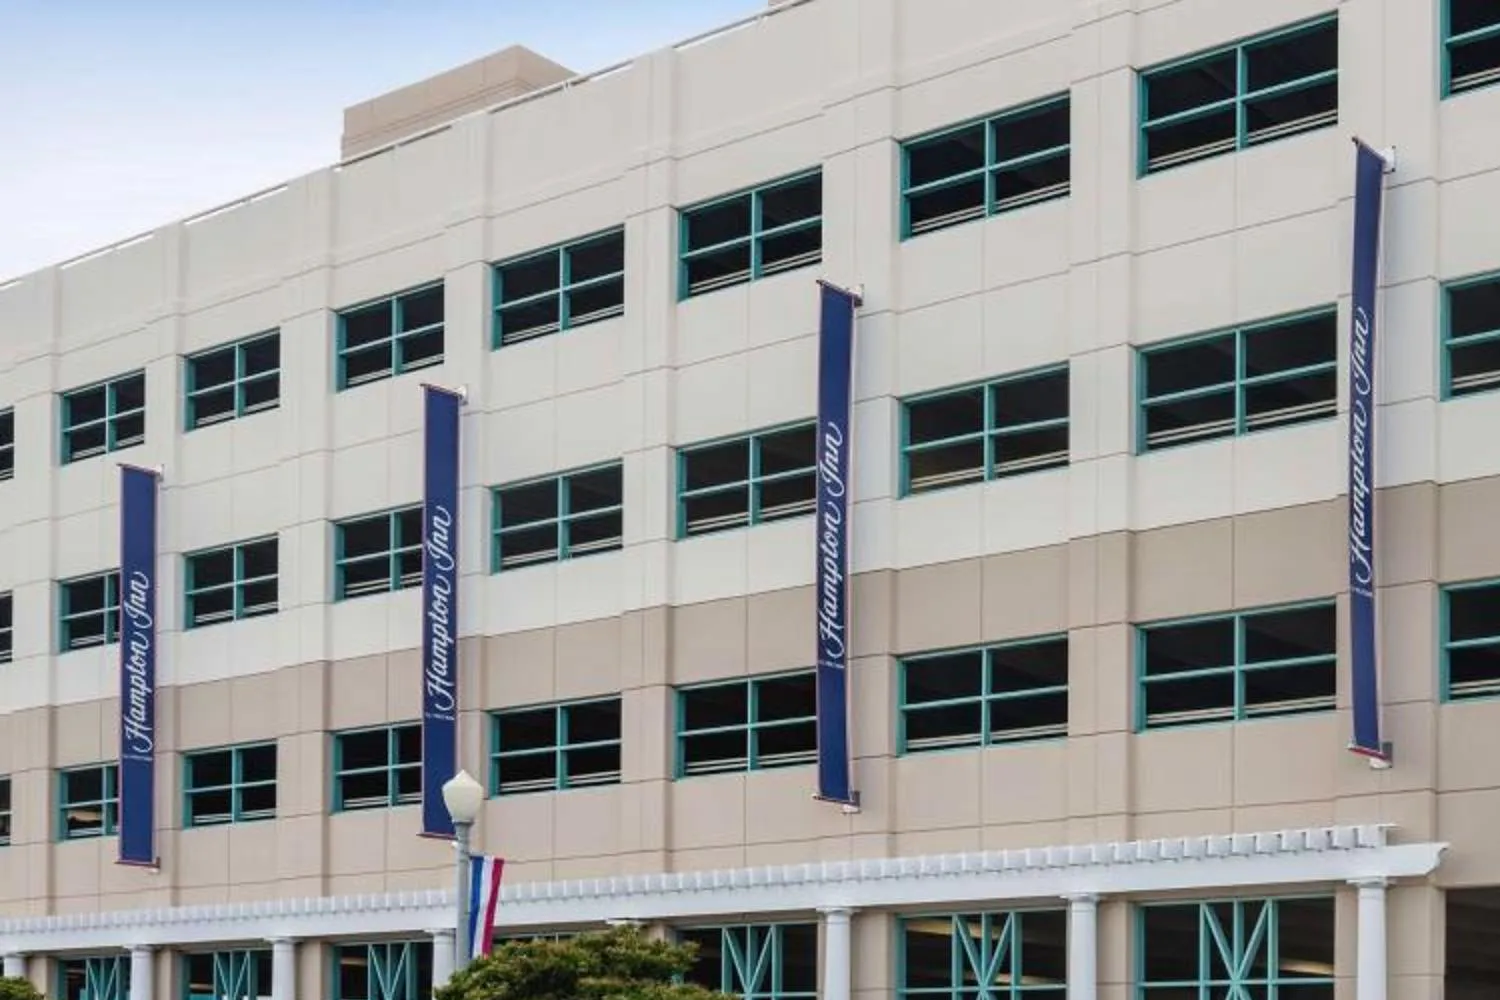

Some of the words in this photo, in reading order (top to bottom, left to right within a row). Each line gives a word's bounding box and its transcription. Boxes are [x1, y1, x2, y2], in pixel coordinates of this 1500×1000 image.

[1352, 307, 1371, 395] Inn
[820, 421, 844, 496] Inn
[1351, 400, 1371, 583] Hampton
[425, 506, 454, 571] Inn
[820, 501, 844, 658] Hampton
[123, 572, 152, 628] Inn
[426, 574, 454, 710] Hampton
[124, 632, 153, 752] Hampton
